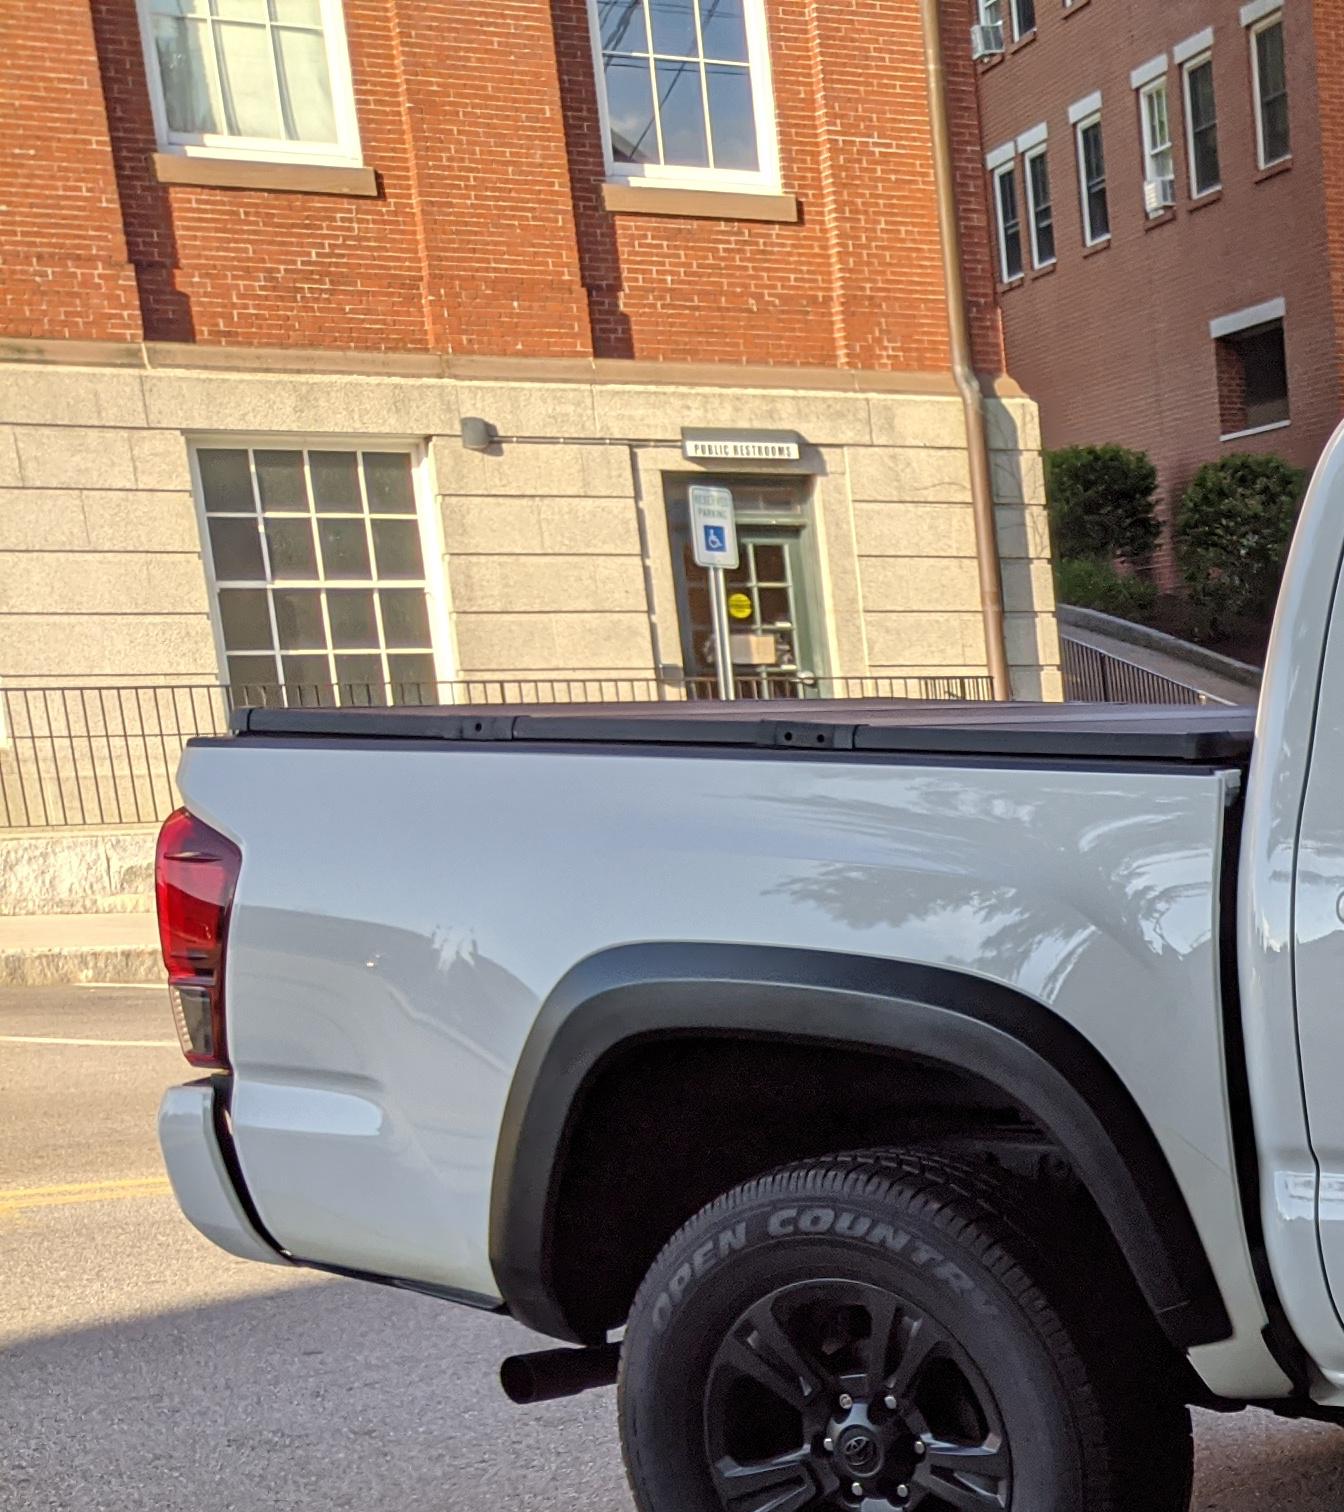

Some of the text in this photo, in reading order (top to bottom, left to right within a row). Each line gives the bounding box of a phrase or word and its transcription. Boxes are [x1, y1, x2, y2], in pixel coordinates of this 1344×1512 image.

[694, 444, 792, 457] PUBLIC RESTROOMS
[652, 1207, 1004, 1332] OPEN COUNTRY
